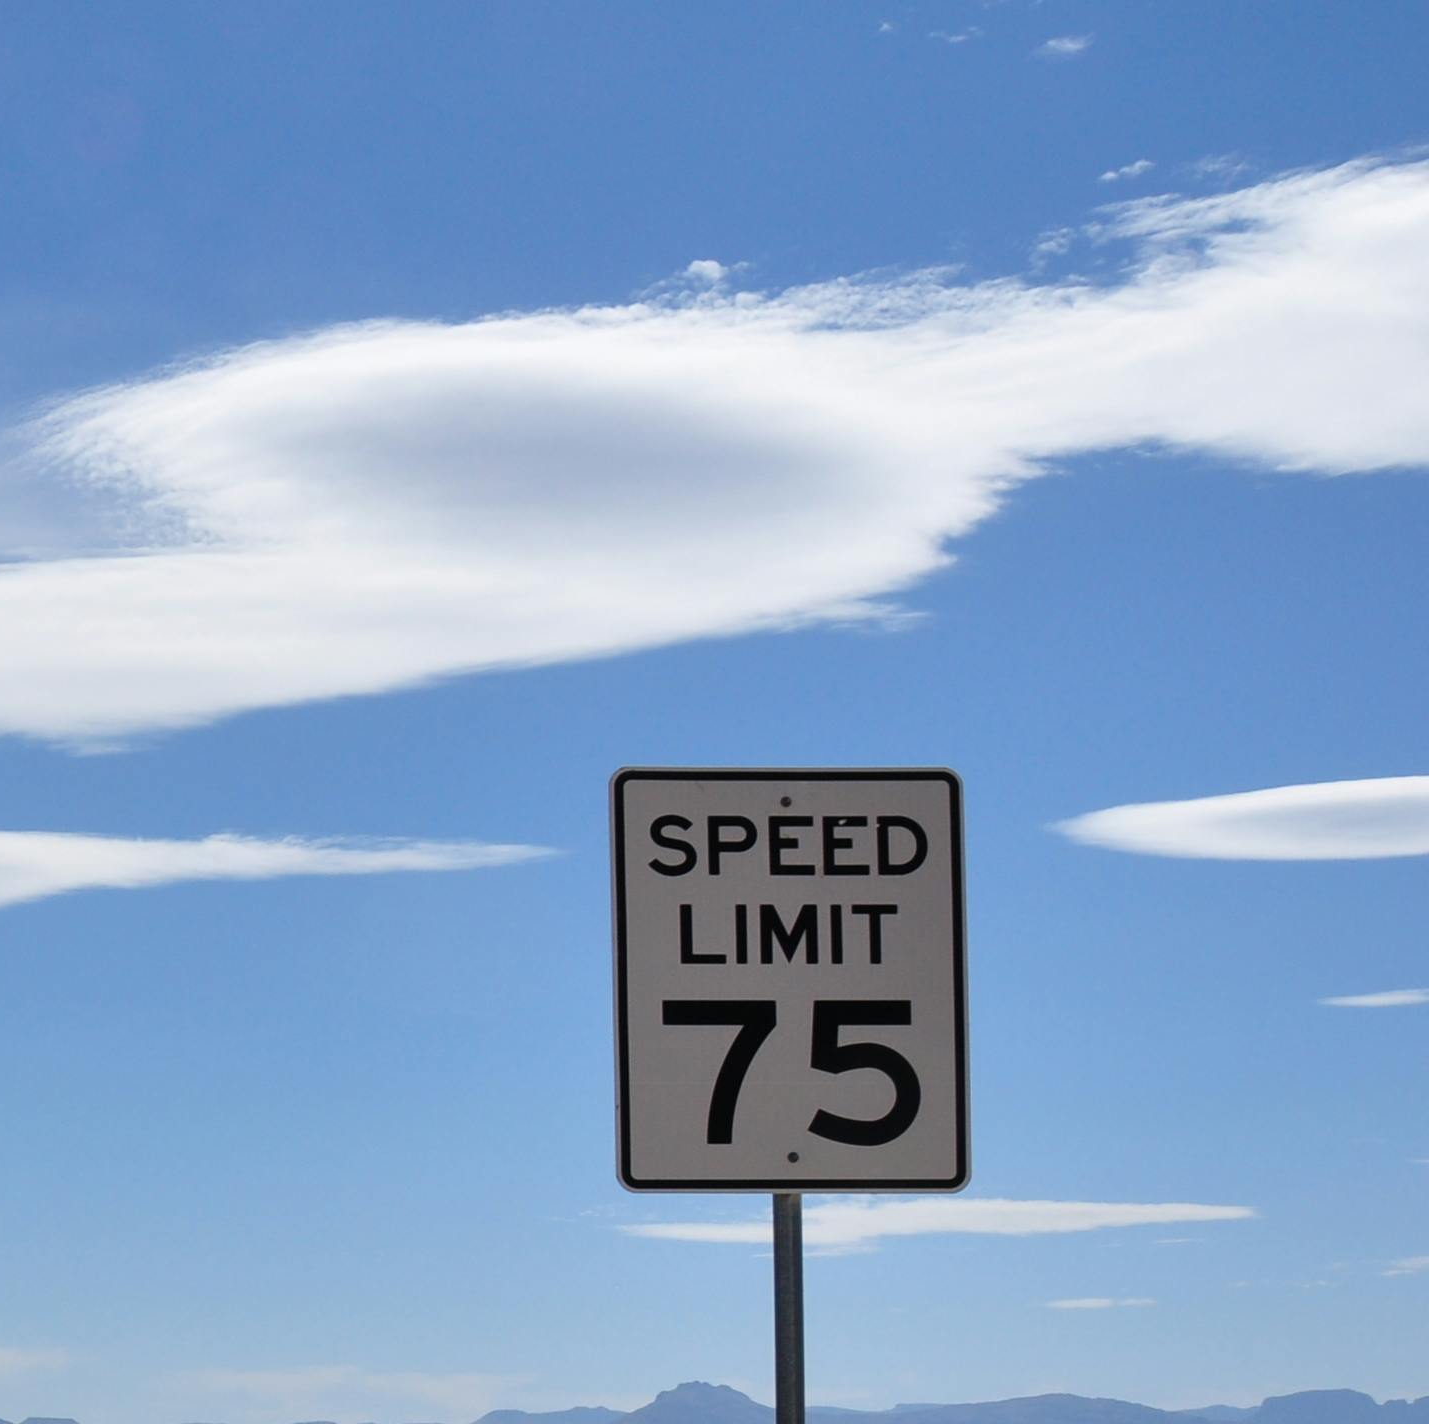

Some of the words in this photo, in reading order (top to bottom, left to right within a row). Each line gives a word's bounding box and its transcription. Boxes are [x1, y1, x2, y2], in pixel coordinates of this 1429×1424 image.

[648, 814, 928, 876] SPEED
[679, 904, 898, 964] LIMIT
[662, 1000, 921, 1146] 75
